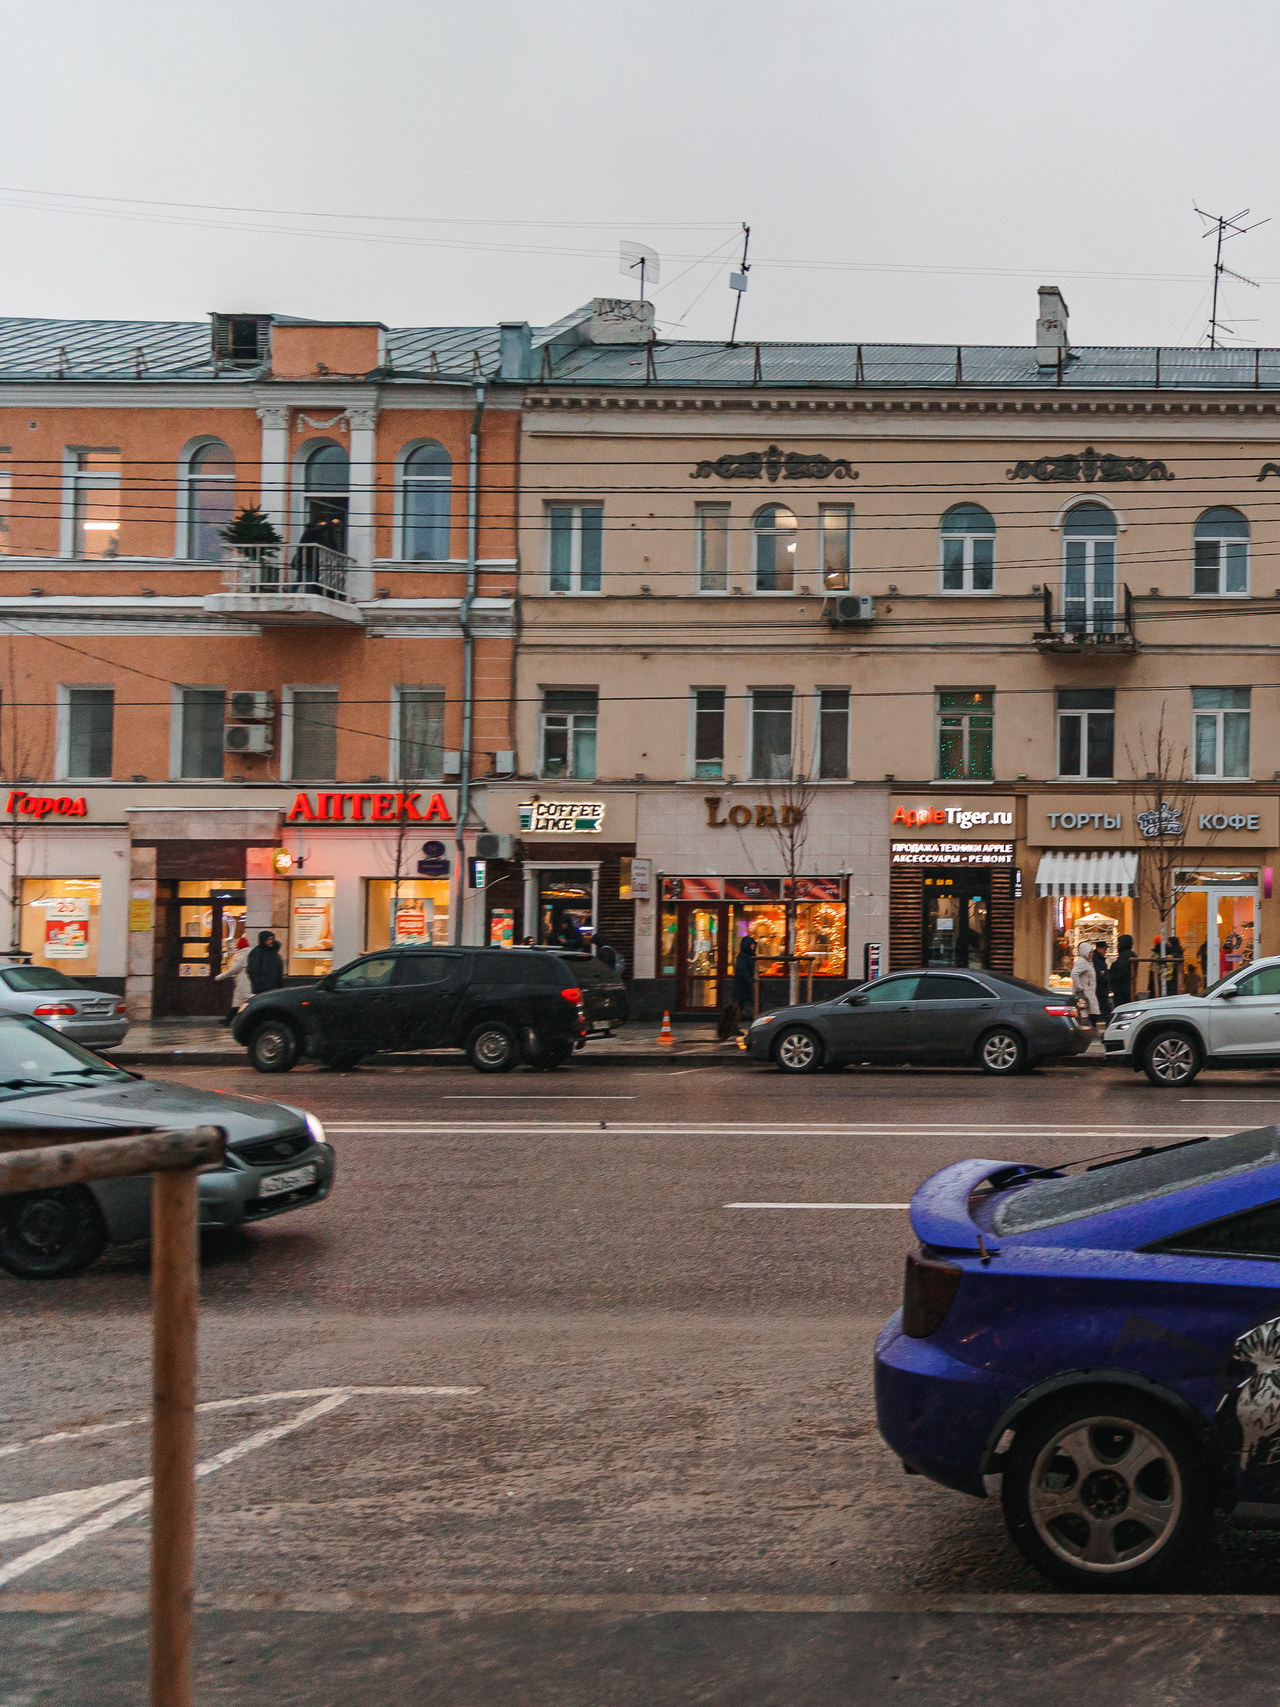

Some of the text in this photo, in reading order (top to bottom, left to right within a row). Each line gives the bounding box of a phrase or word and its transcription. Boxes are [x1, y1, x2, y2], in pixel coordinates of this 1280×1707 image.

[5, 791, 87, 818] Город
[288, 792, 451, 820] АПТЕКА
[536, 803, 602, 817] COFFEE
[535, 818, 573, 830] LIKE
[892, 805, 1014, 830] AppleTiger.ru
[1047, 813, 1122, 829] ТОРТЫ
[1199, 813, 1260, 830] КОФЕ
[892, 843, 1013, 853] ПРОДАЖА ТЕХНИКИ APPLE
[892, 854, 960, 863] АКСЕССУАРЫ
[968, 854, 1013, 863] РЕМОНТ
